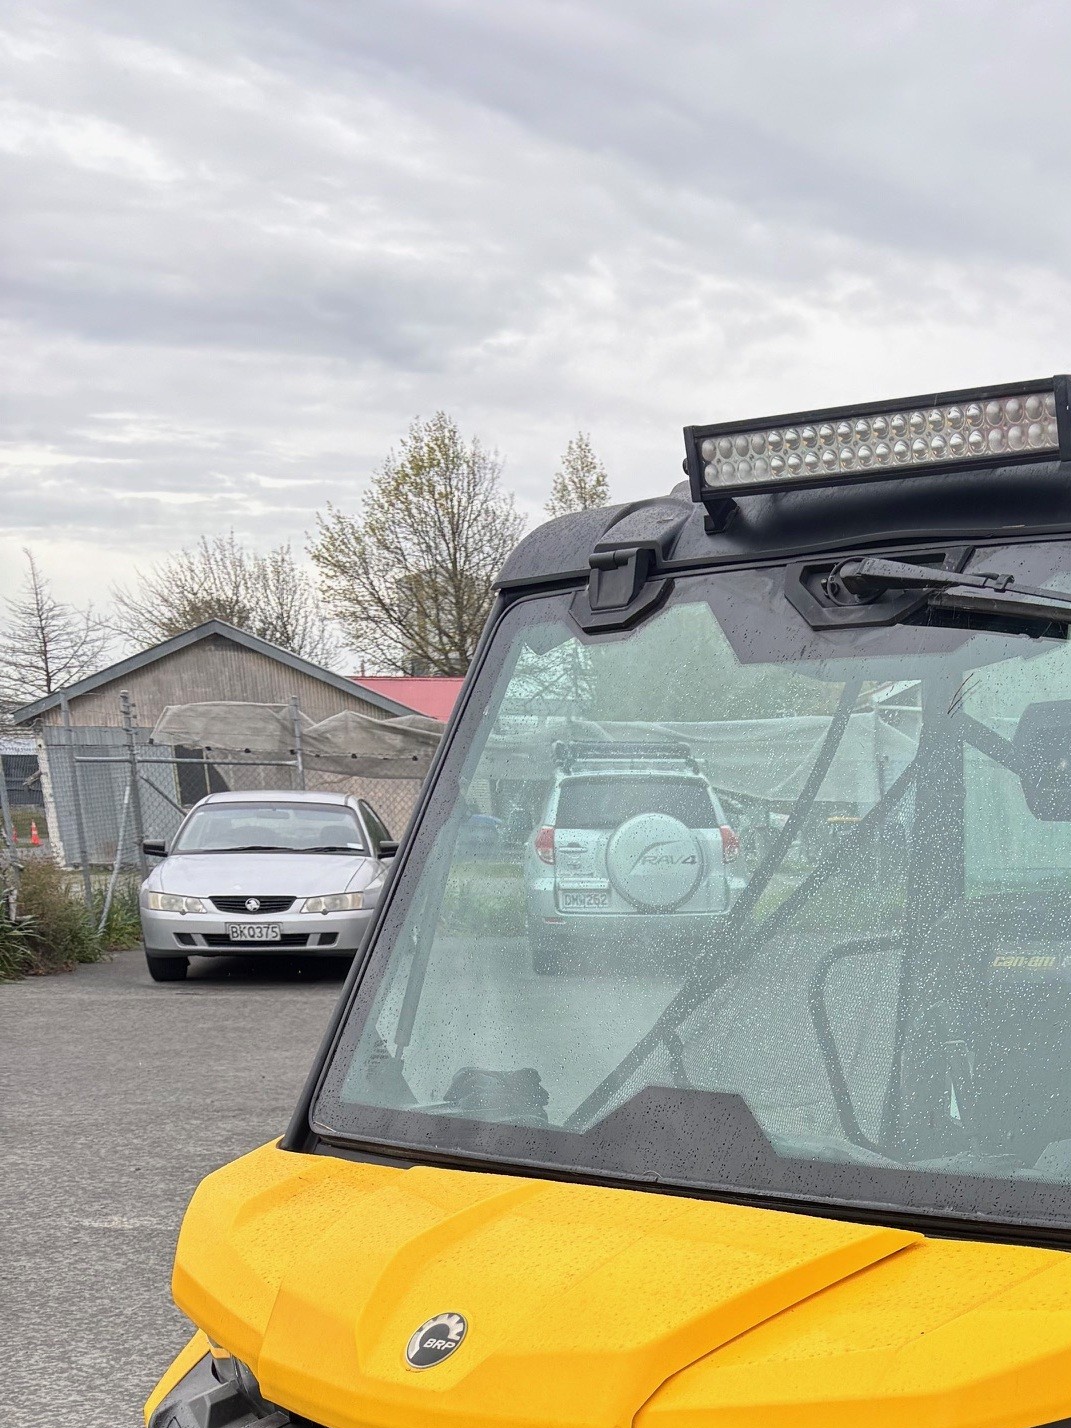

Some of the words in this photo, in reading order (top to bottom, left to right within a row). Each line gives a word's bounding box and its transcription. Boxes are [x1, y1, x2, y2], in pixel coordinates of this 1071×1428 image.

[639, 854, 697, 866] RAV4
[230, 925, 279, 939] BKQ375
[423, 1338, 456, 1351] BRP
